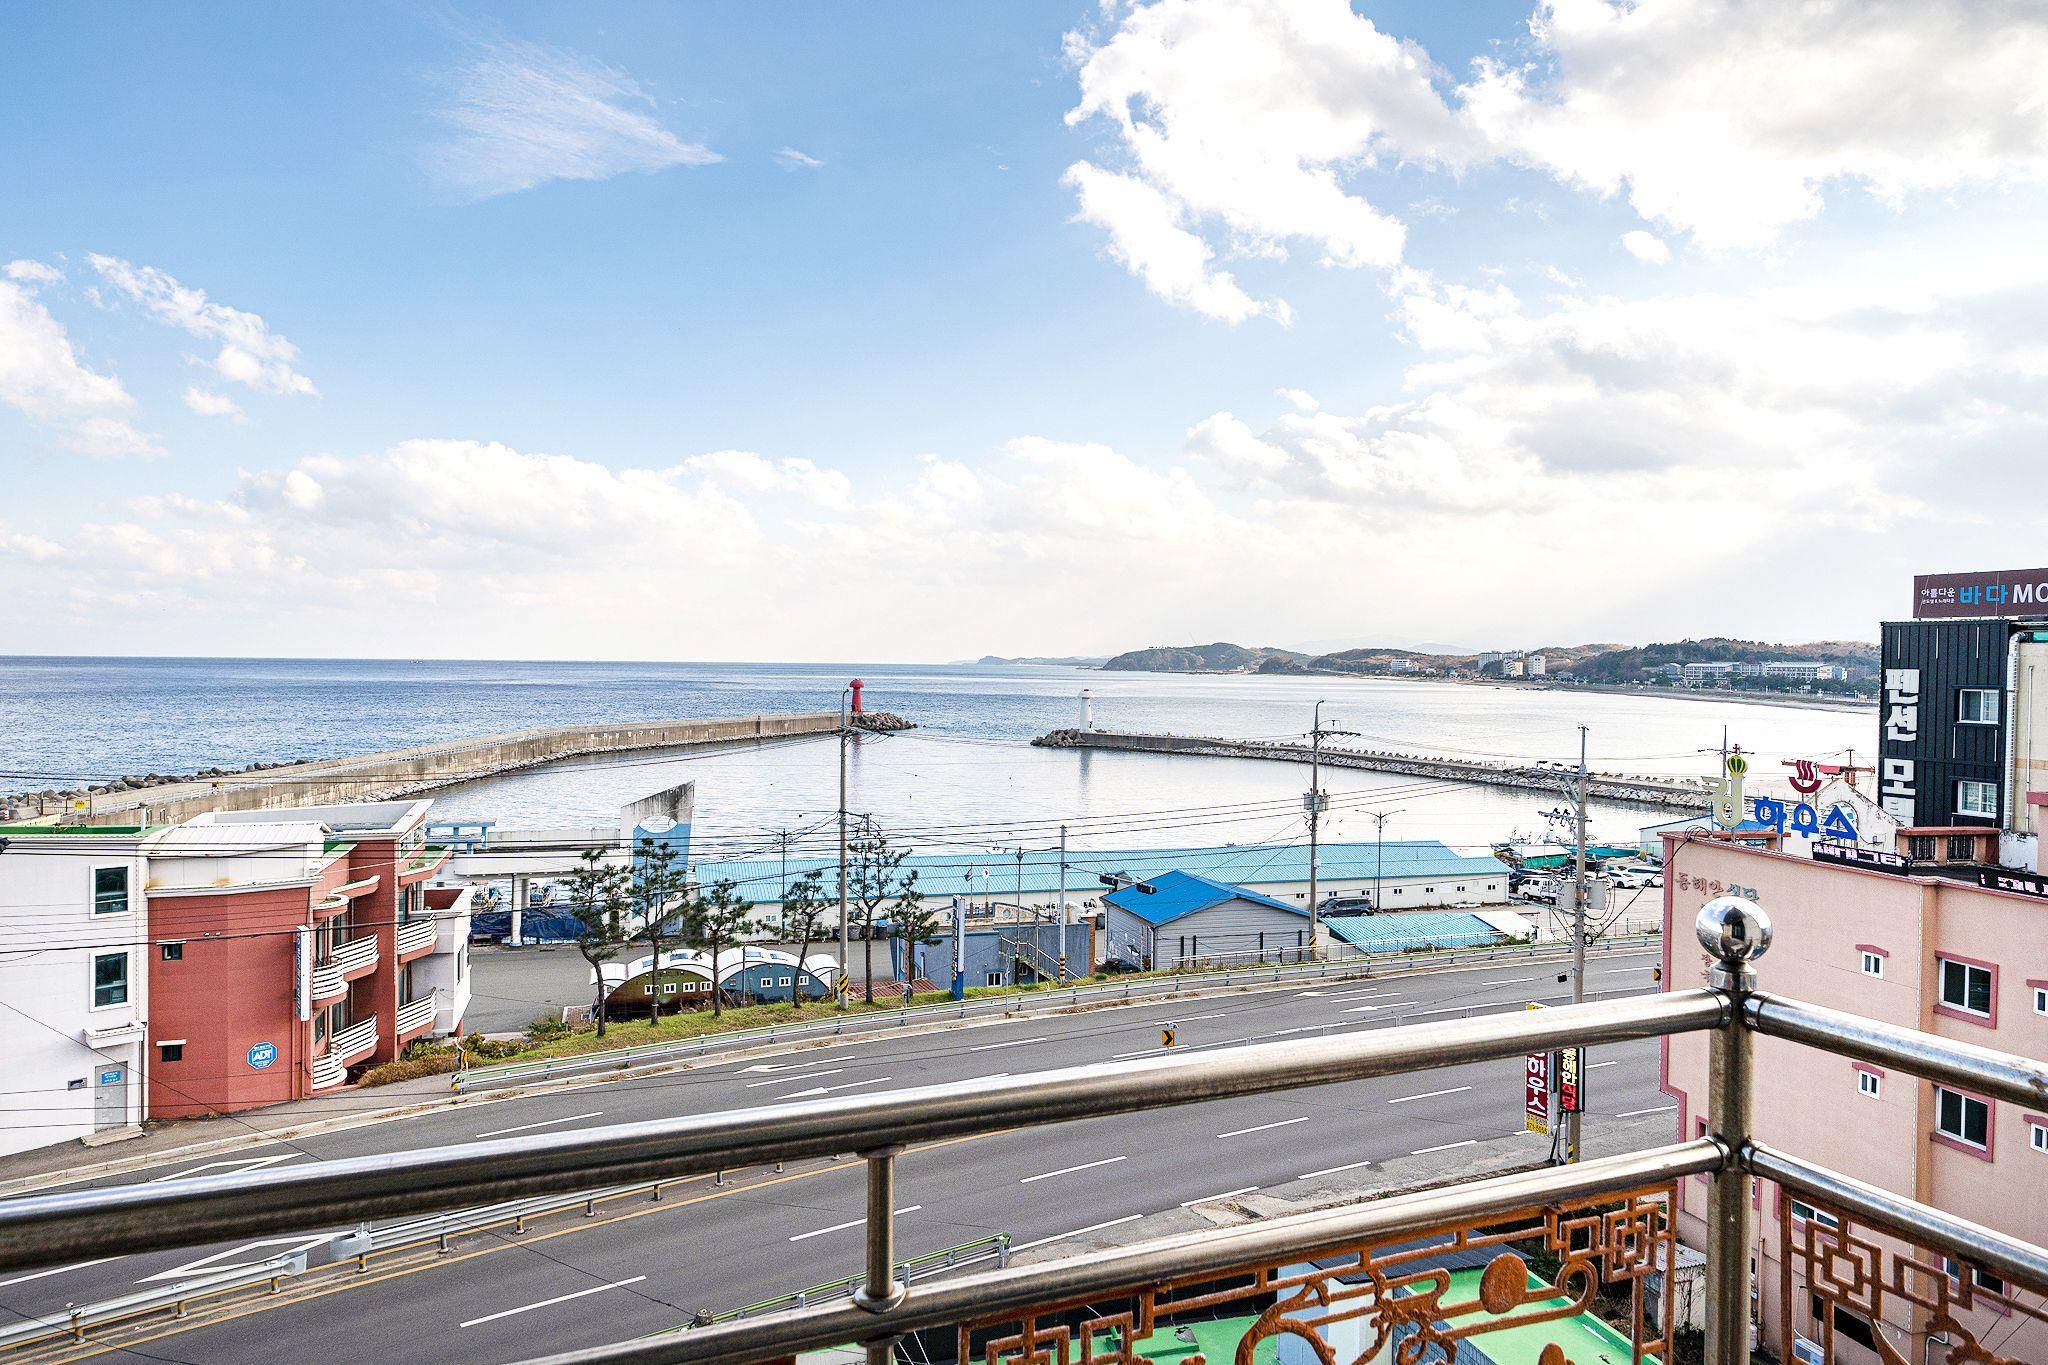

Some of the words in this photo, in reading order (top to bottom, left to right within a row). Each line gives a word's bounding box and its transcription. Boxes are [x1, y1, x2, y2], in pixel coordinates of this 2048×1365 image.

[1921, 587, 1955, 598] 아름다운
[1959, 584, 2008, 605] 바다
[1885, 668, 1919, 741] 펜션
[1675, 872, 1724, 896] 동해안
[252, 1050, 272, 1060] ADT
[1527, 1052, 1547, 1117] 하우스
